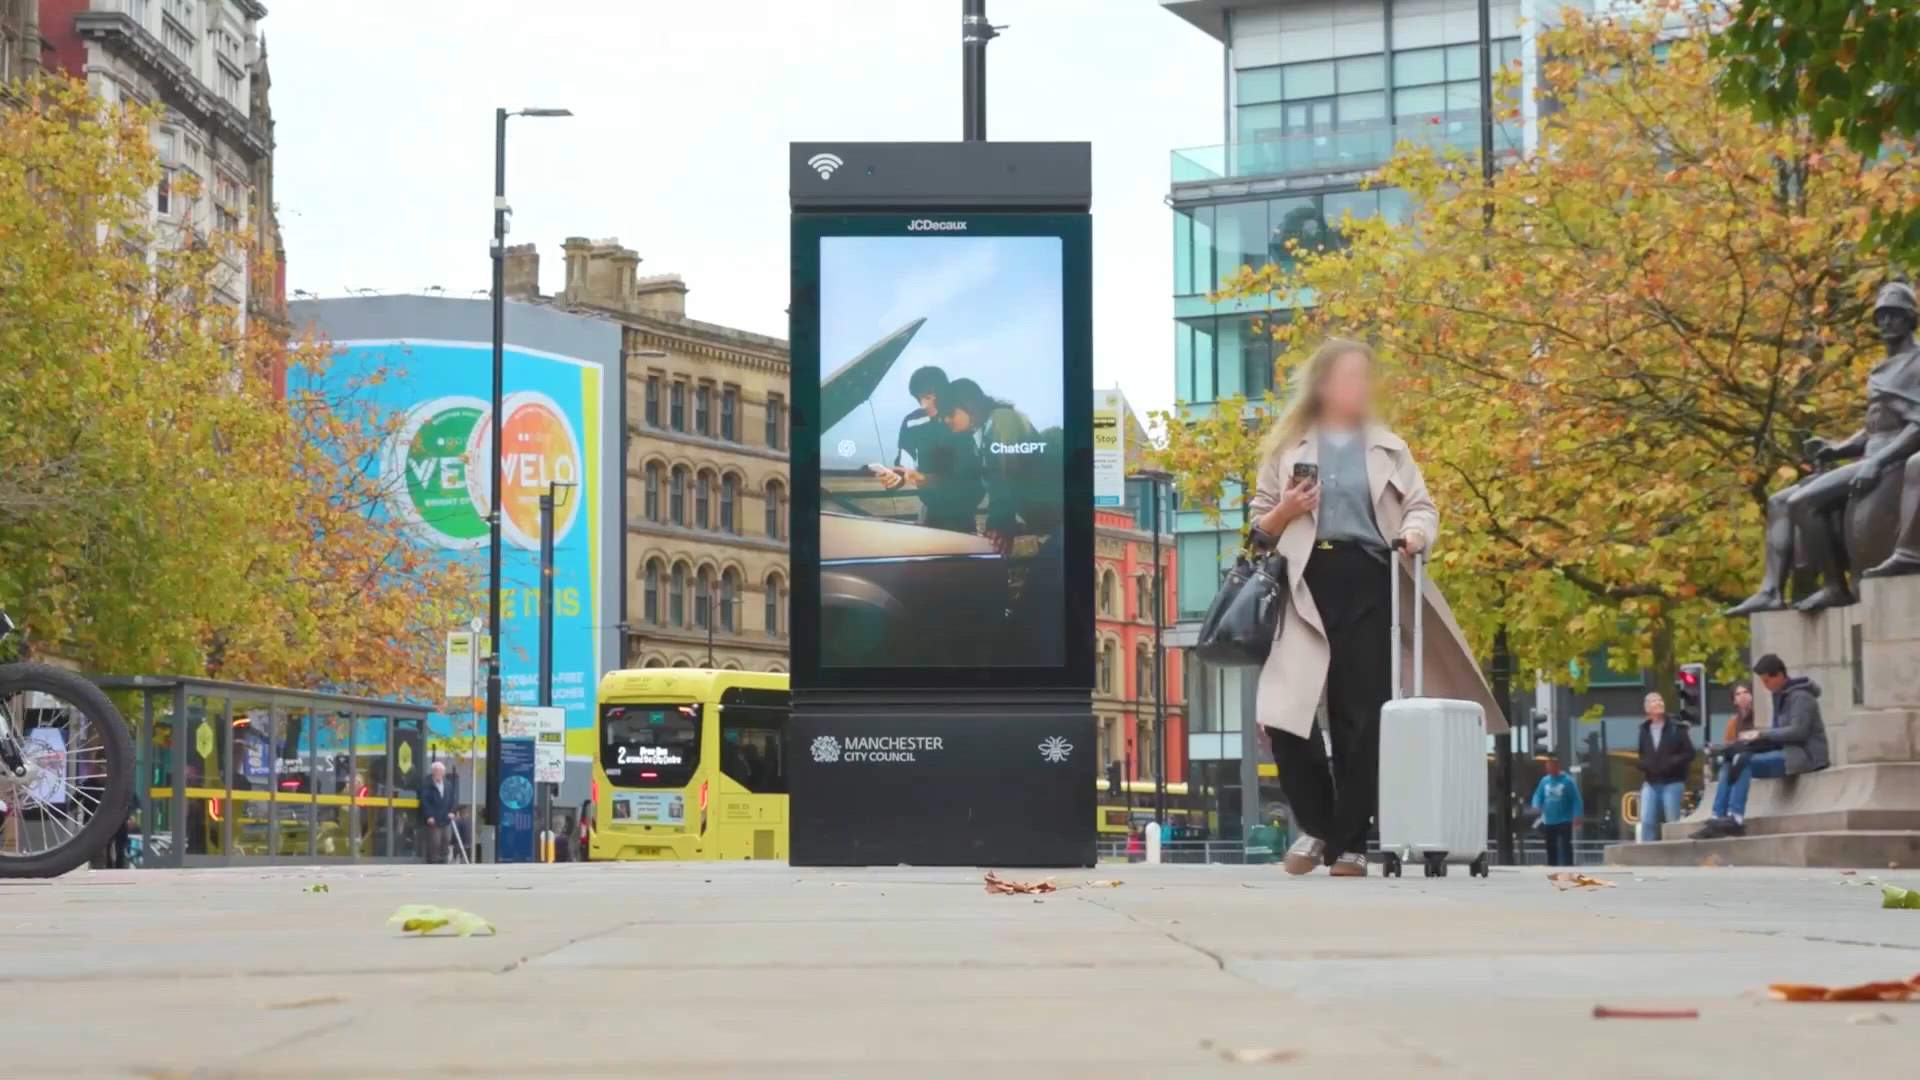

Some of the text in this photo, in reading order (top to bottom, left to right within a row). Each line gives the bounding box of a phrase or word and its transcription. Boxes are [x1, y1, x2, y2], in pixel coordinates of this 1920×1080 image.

[907, 219, 967, 231] JCDecaux
[1096, 434, 1117, 445] Stop
[990, 442, 1047, 454] ChatGPT
[408, 456, 466, 489] VE
[501, 452, 575, 487] VELO
[844, 736, 944, 750] MANCHESTER
[618, 746, 626, 765] 2
[844, 752, 916, 762] CITY COUNCIL
